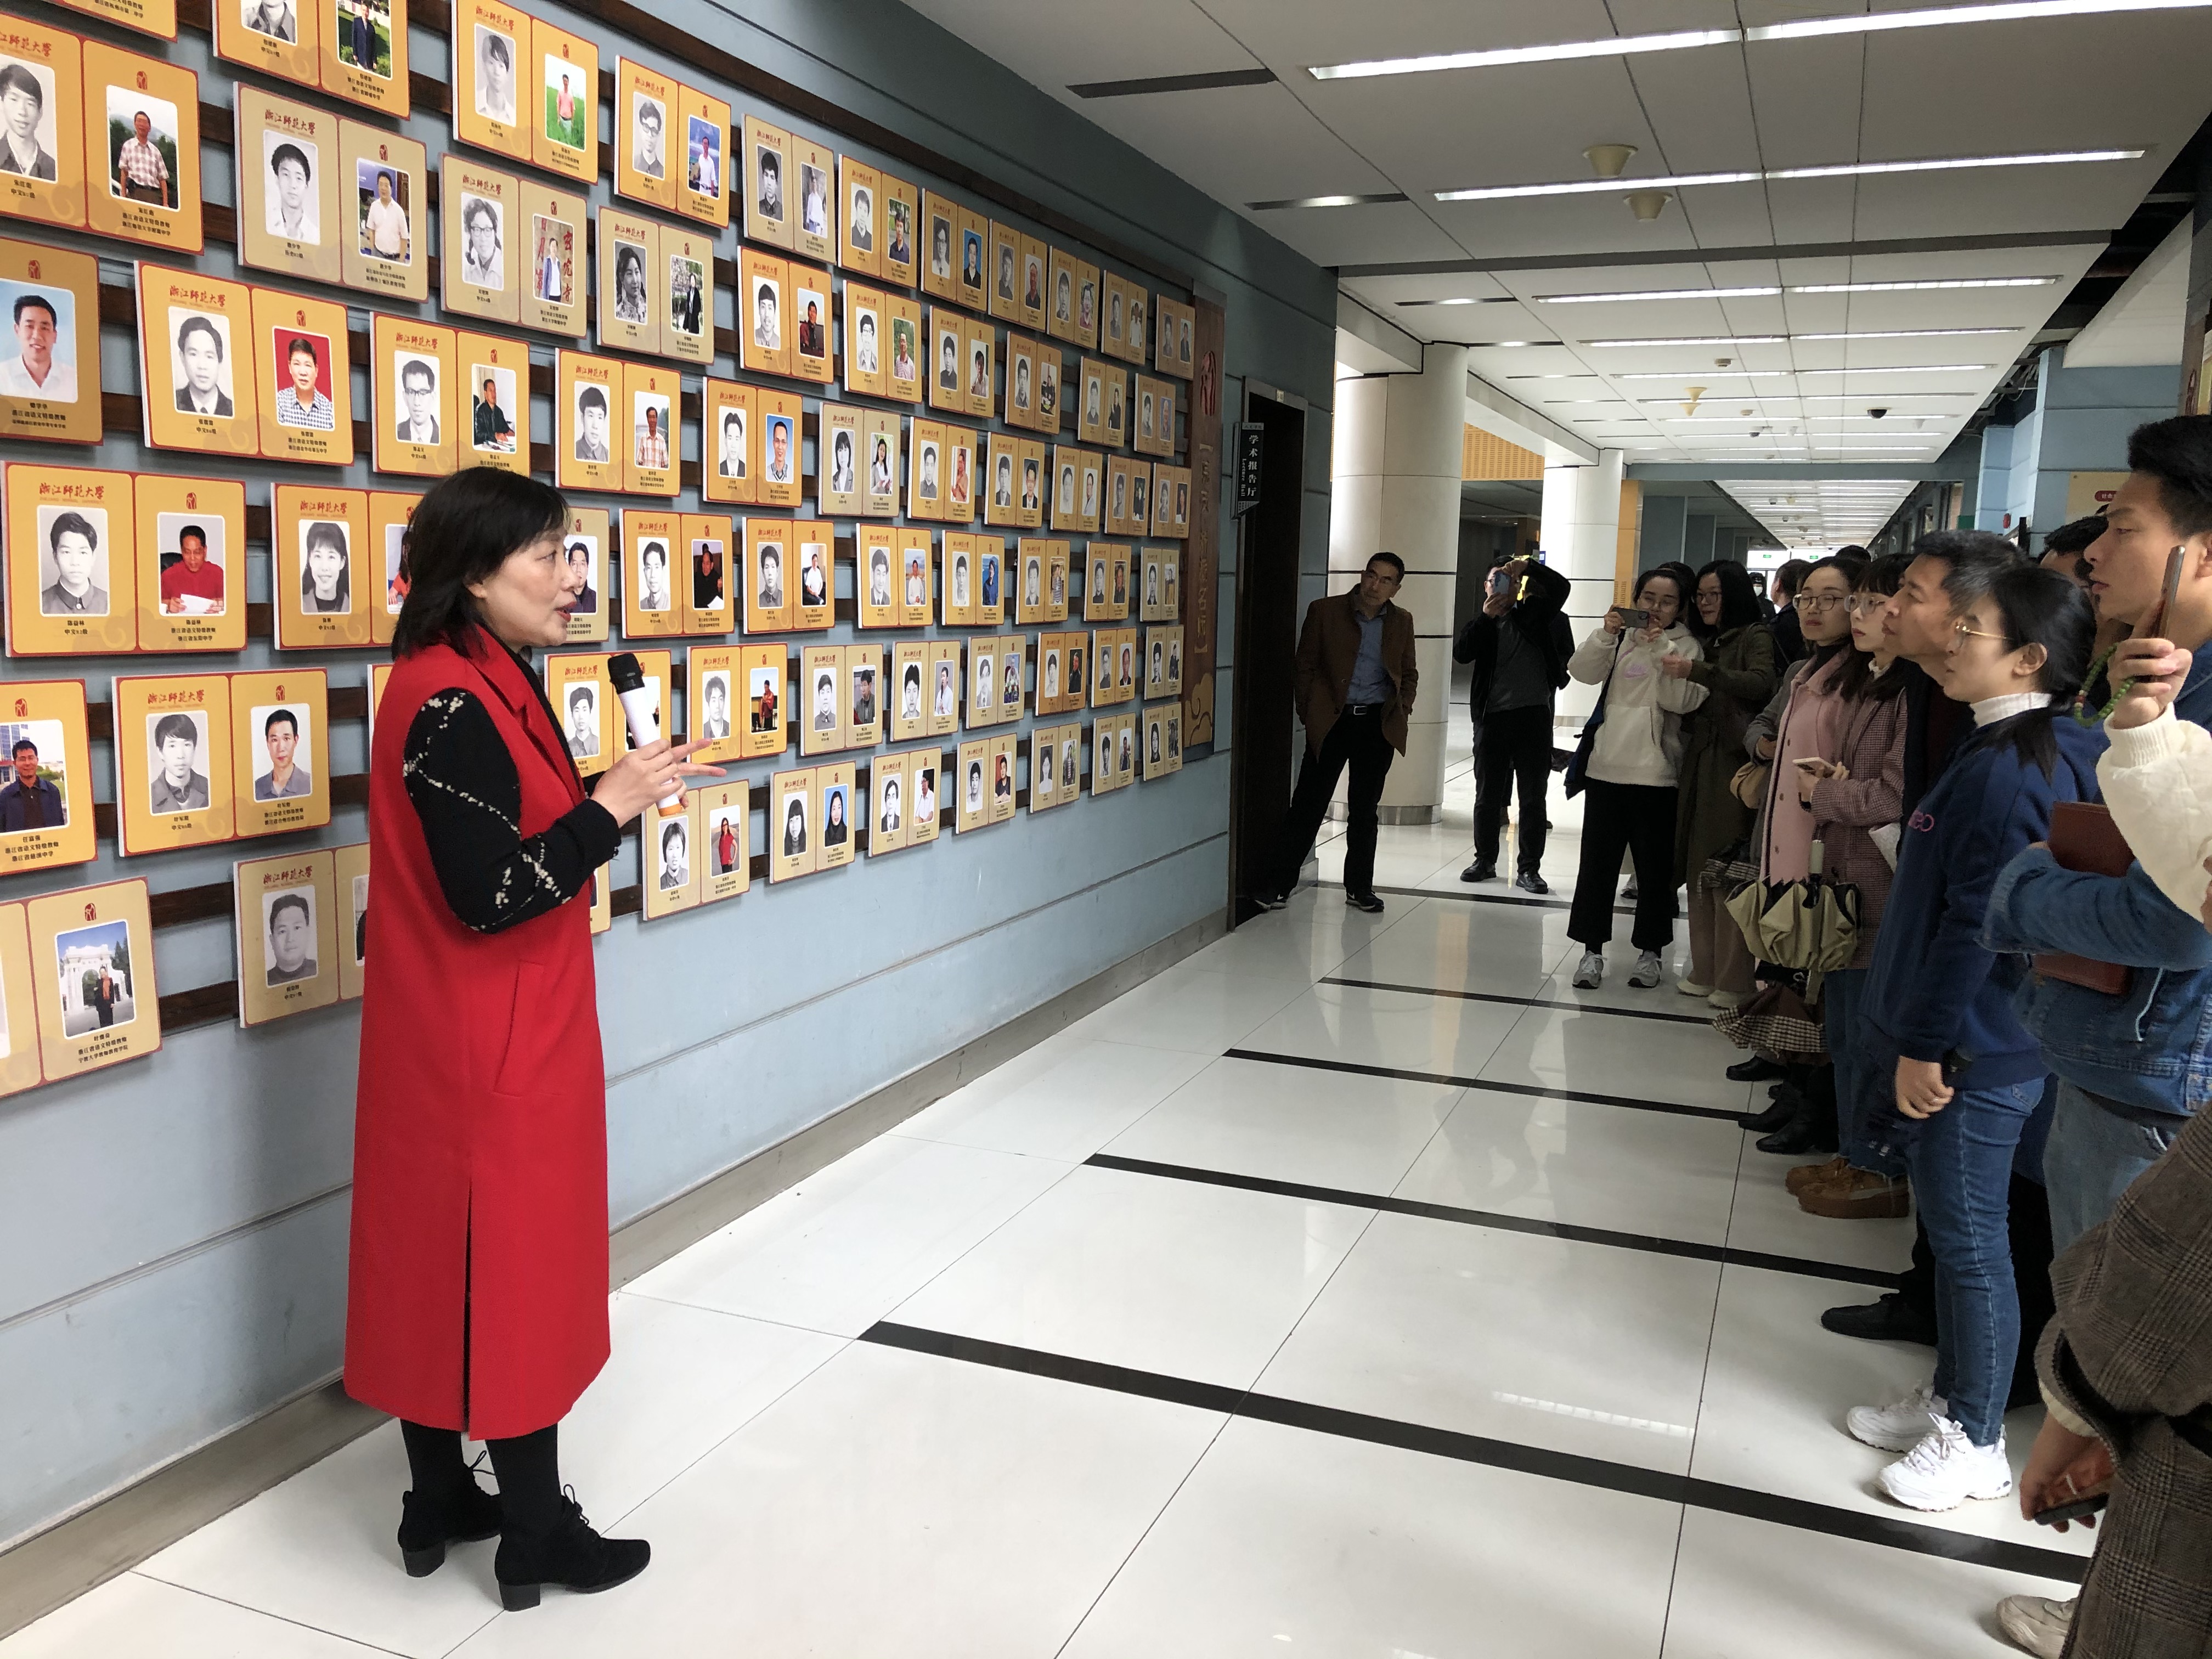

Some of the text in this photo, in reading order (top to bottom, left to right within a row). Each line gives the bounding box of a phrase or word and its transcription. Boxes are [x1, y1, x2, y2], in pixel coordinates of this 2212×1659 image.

[1247, 435, 1259, 496] 学术报告厅
